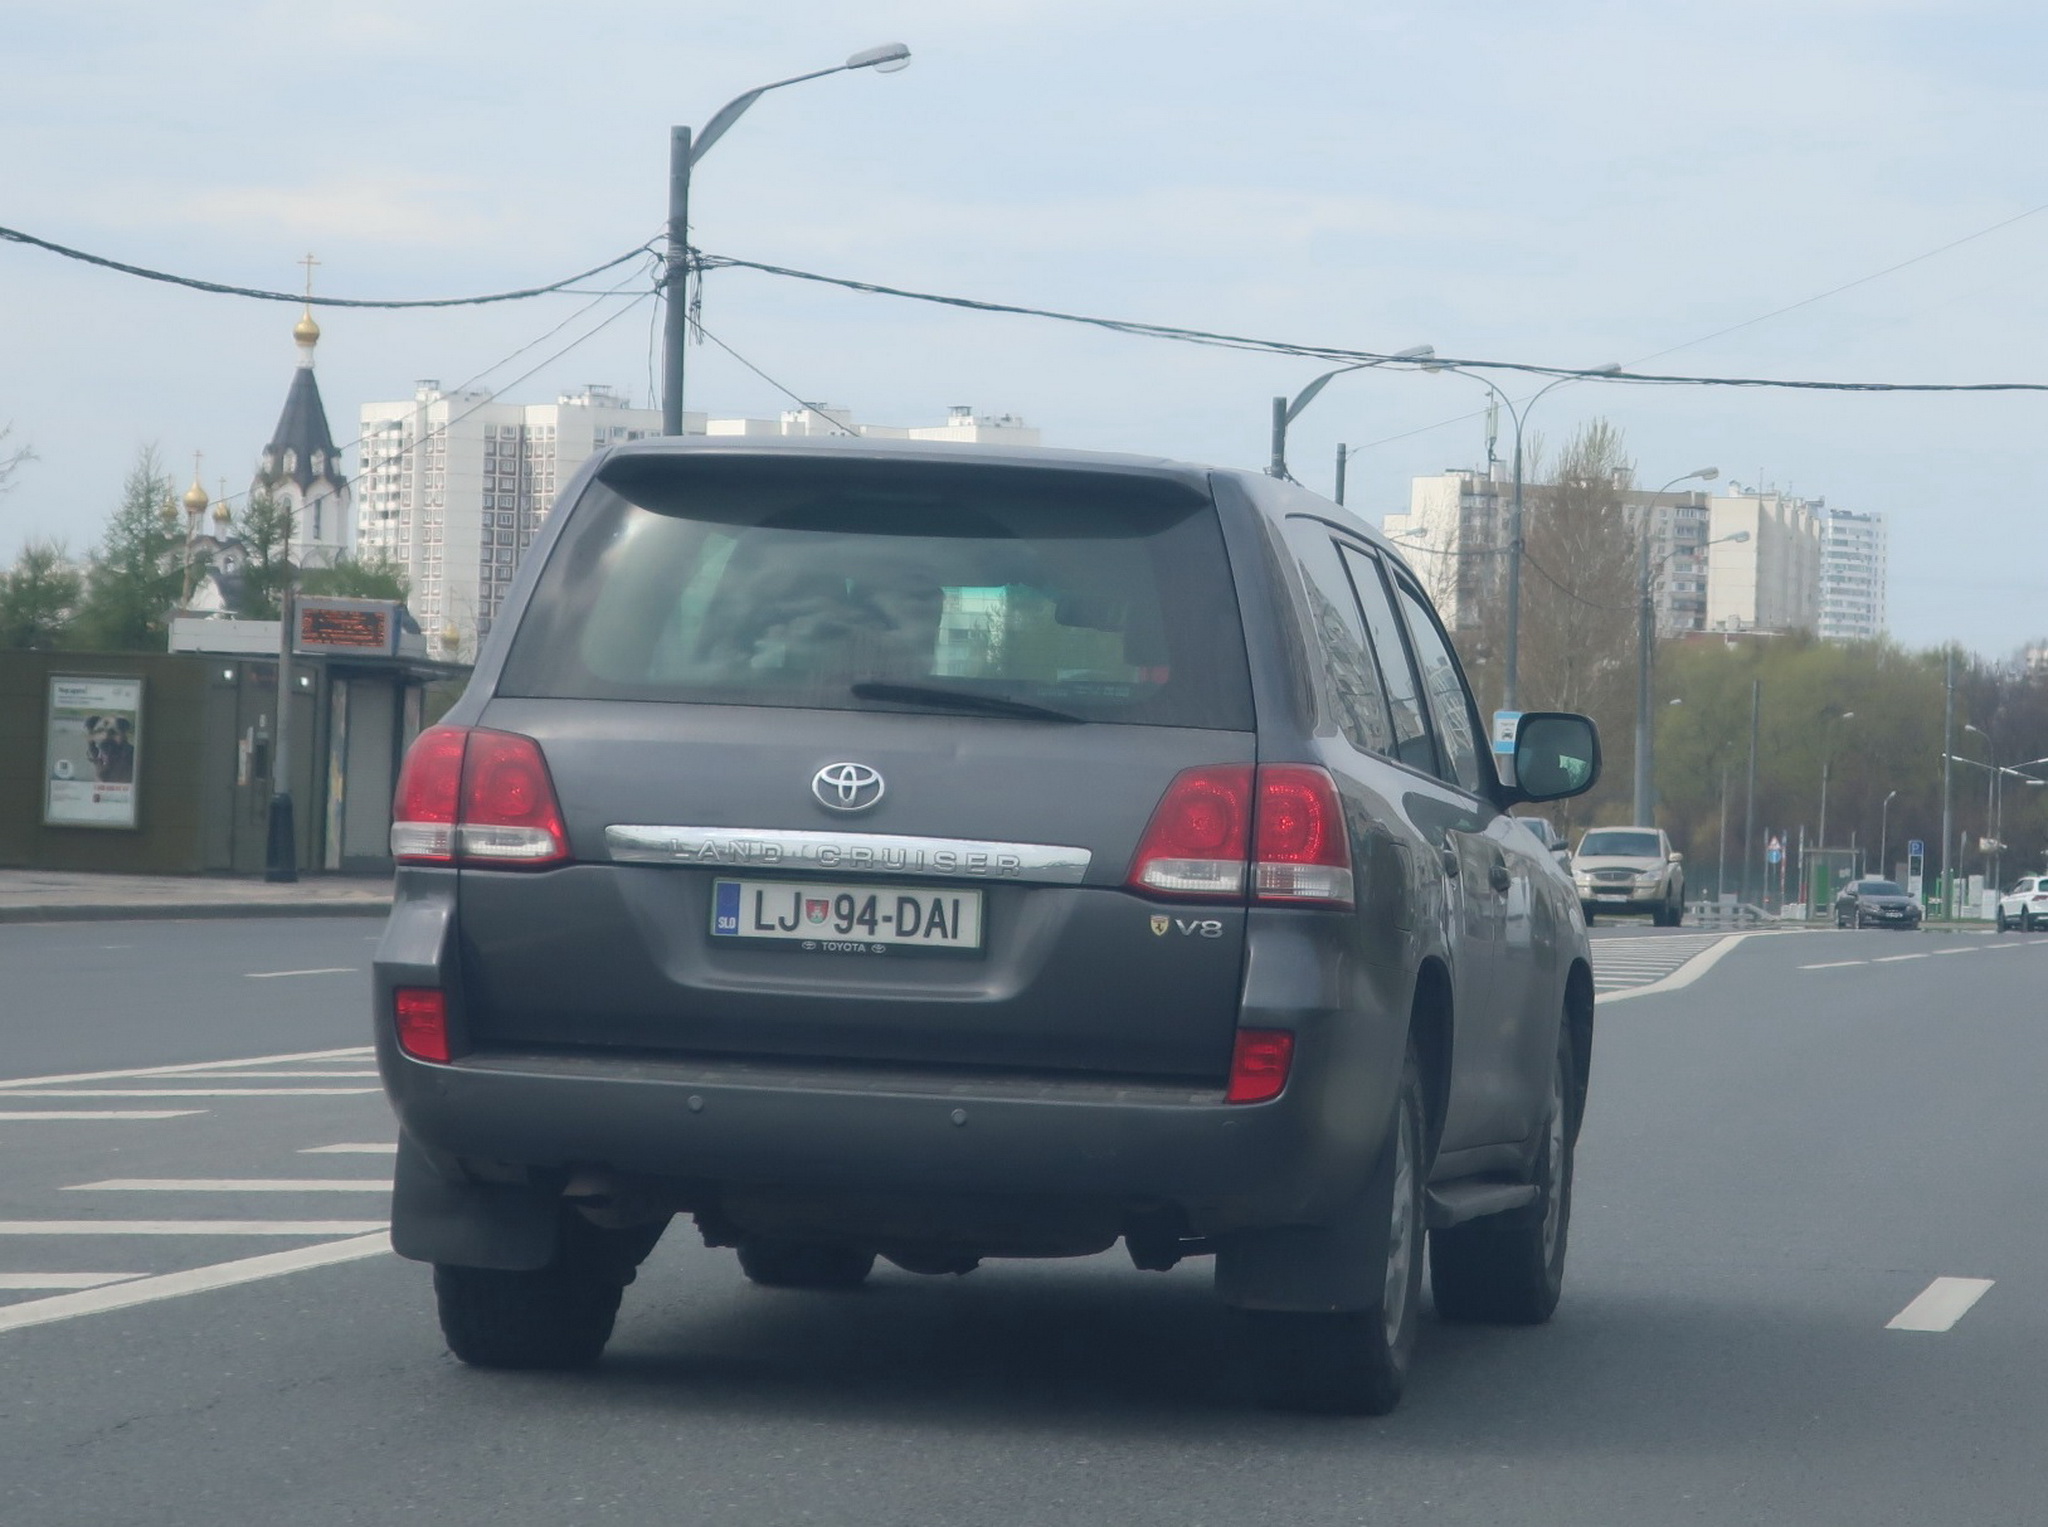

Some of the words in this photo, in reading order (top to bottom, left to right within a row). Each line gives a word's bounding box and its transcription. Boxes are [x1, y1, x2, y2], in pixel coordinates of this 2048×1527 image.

[669, 838, 784, 864] LAND
[816, 844, 1021, 876] CRUISER
[717, 917, 736, 930] SLO
[754, 889, 800, 931] LJ
[833, 893, 960, 939] 94-DAI
[1174, 918, 1222, 938] V8
[821, 940, 867, 953] TOYOTA
